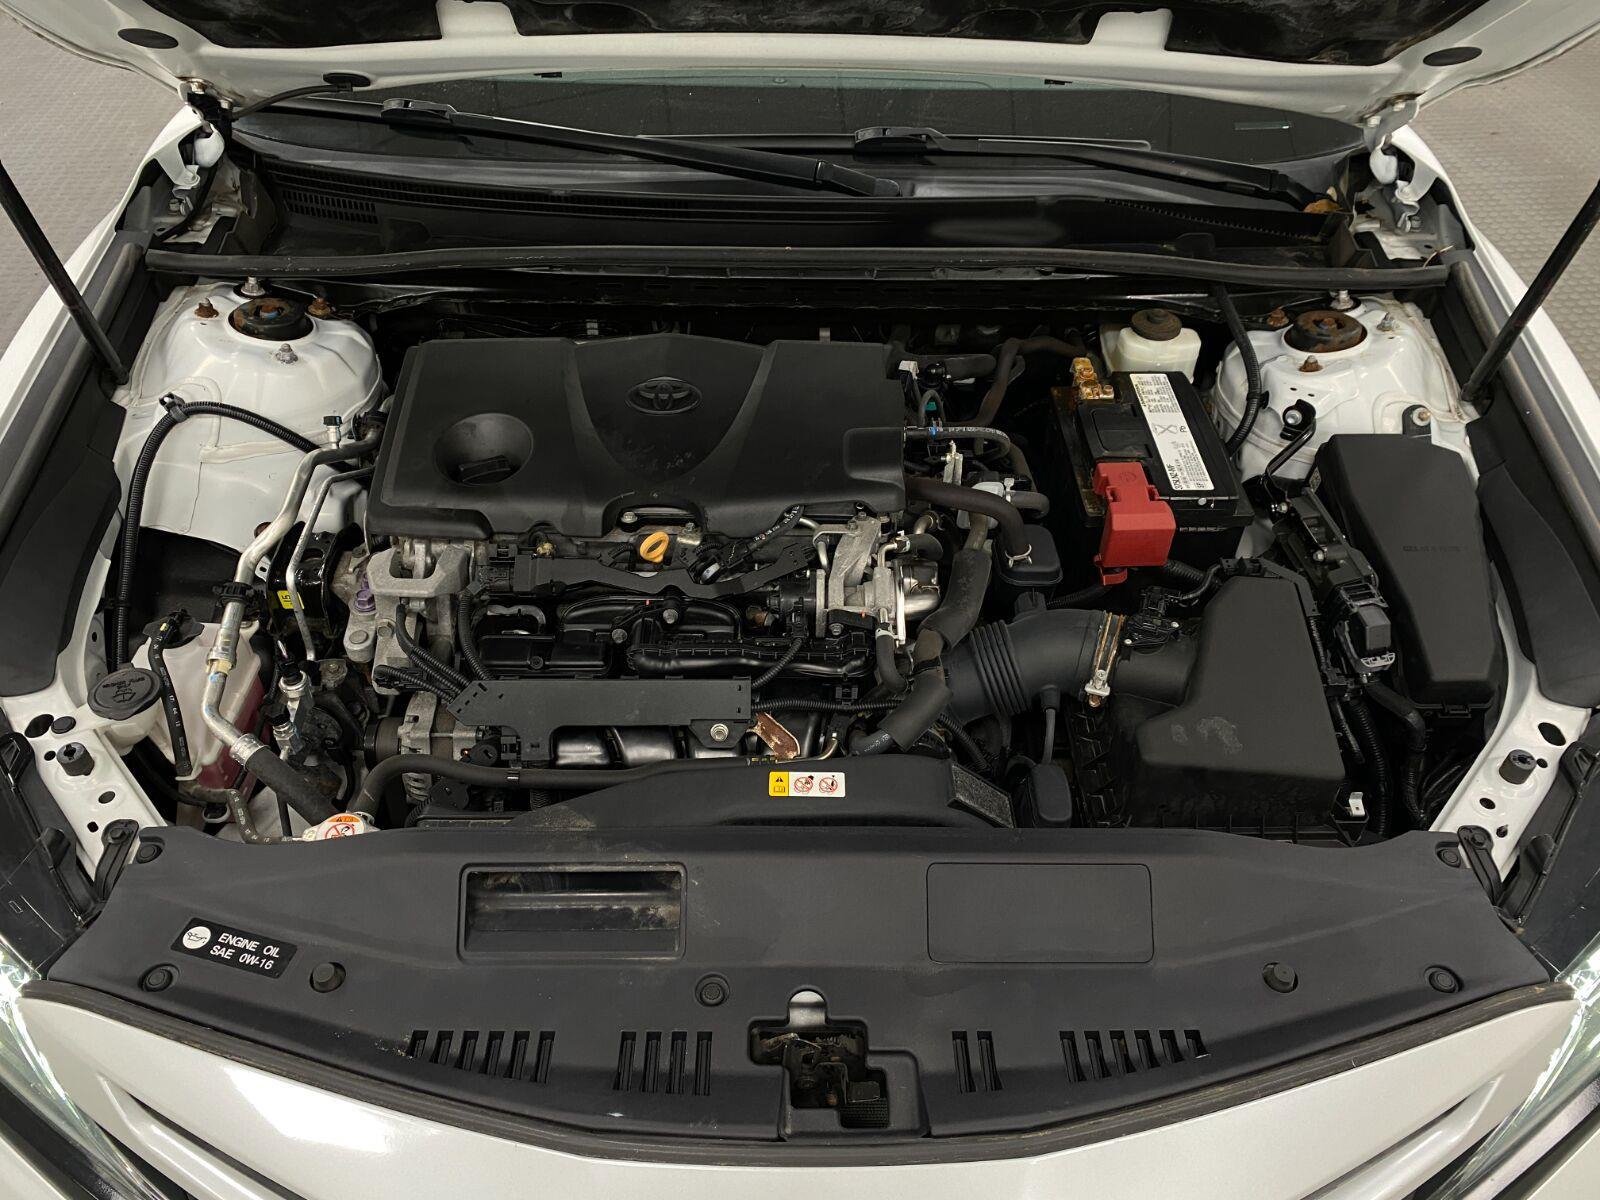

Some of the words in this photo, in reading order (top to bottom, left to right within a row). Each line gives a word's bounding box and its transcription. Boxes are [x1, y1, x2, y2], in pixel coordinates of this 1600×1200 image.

[210, 945, 235, 959] SAE
[238, 953, 274, 970] 0W-16
[218, 932, 260, 952] ENGINE
[263, 945, 280, 958] OIL
